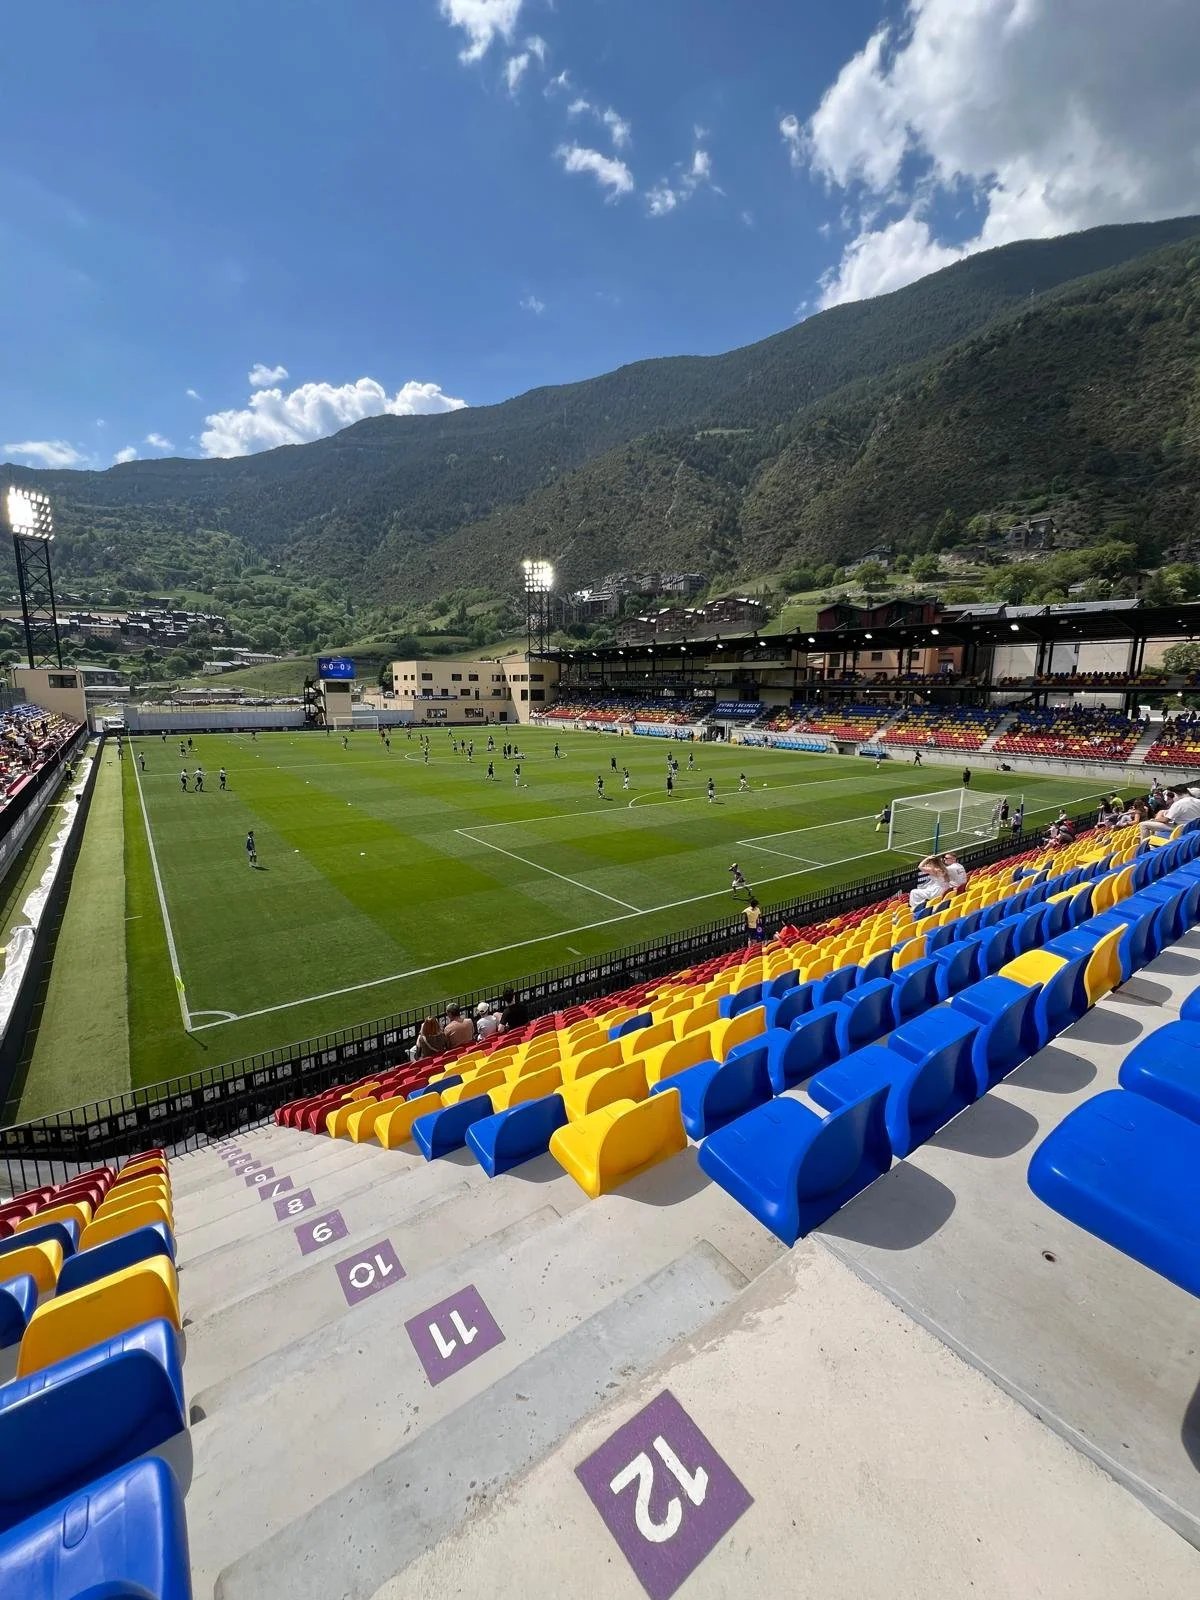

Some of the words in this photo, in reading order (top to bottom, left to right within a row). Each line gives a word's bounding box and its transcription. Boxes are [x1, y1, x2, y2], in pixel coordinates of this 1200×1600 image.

[287, 1198, 304, 1214] 8
[312, 1222, 333, 1242] 9
[349, 1254, 393, 1289] 10
[428, 1310, 478, 1359] 11
[609, 1435, 708, 1543] 12
